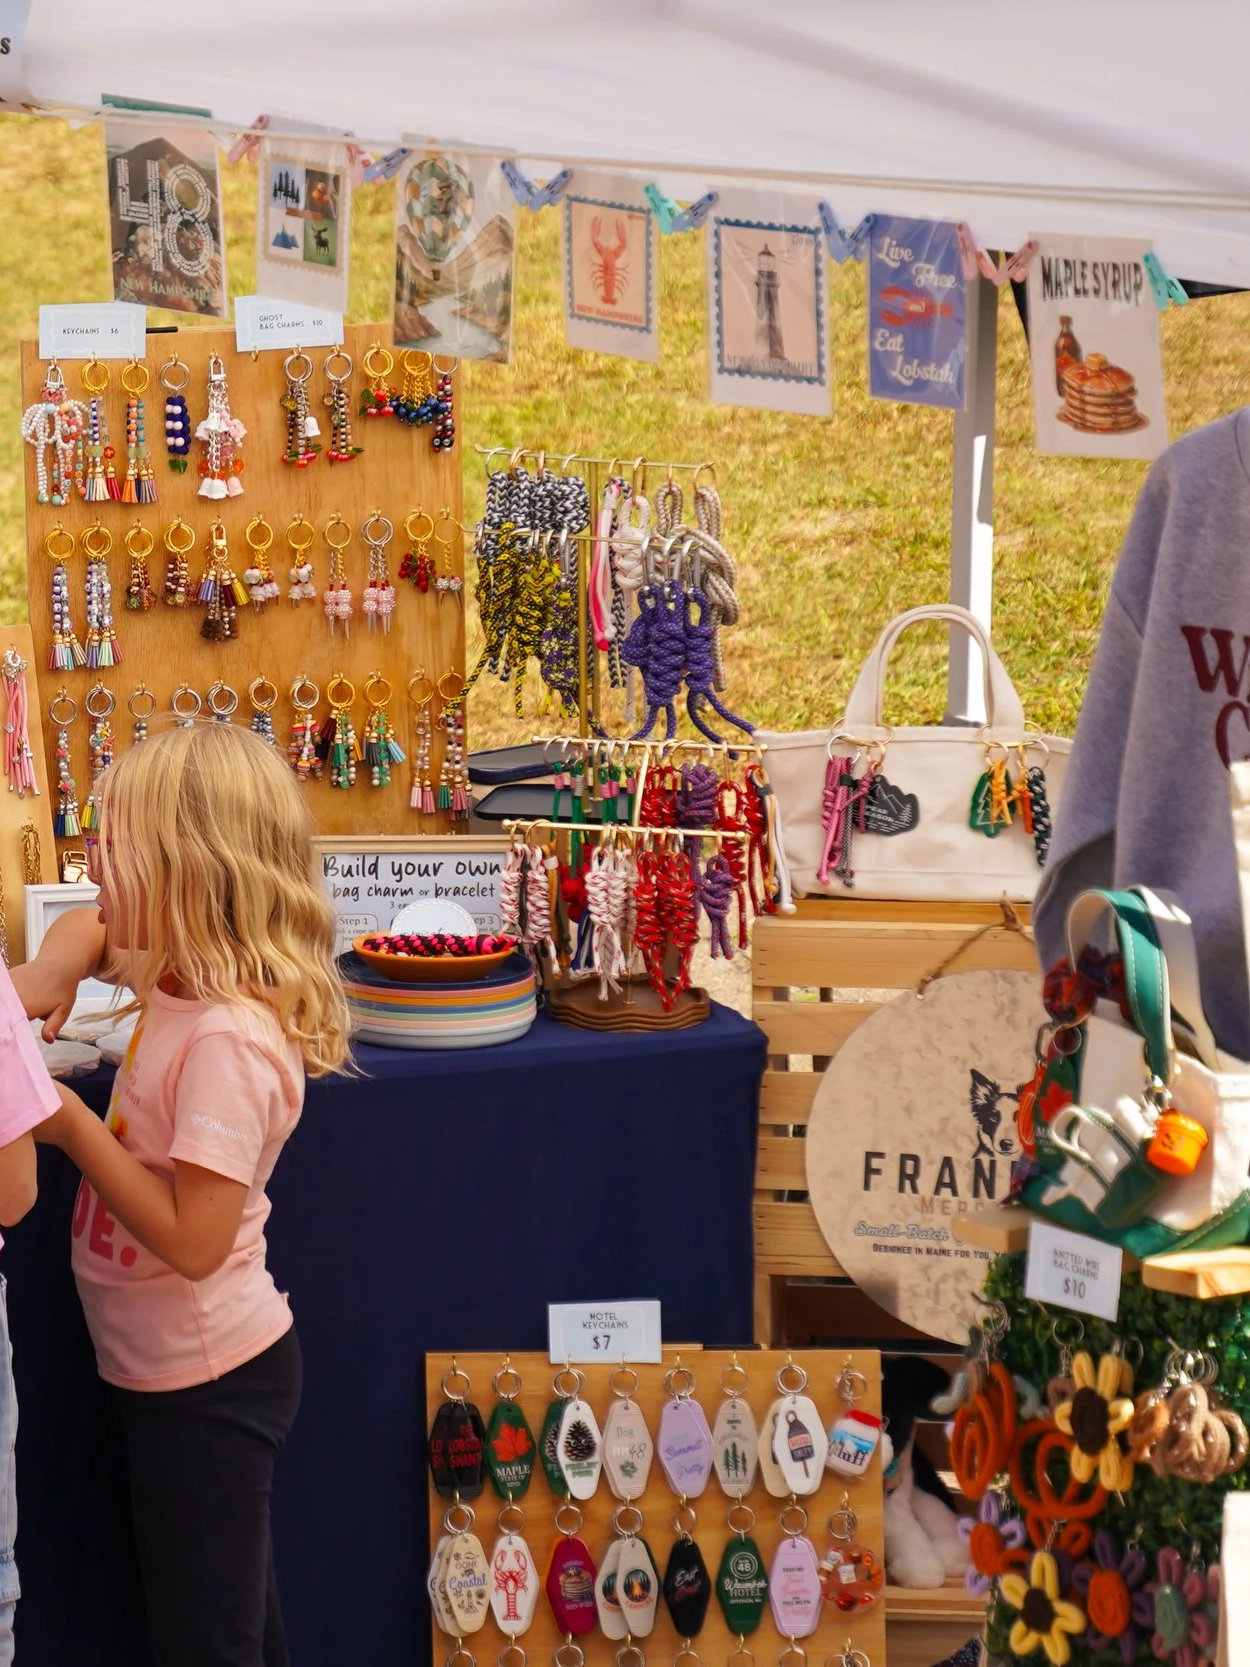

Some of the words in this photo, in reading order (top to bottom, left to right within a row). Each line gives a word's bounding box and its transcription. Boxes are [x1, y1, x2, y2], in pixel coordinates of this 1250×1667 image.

[877, 237, 914, 268] Live
[911, 262, 957, 288] Free
[1041, 255, 1089, 302] MAPLE
[1093, 259, 1143, 307] SYRUP
[120, 278, 144, 290] NEW
[62, 327, 100, 335] KEYCHAINS
[874, 328, 904, 352] Eat
[891, 355, 955, 386] Lobstah
[864, 810, 895, 823] EASON
[323, 855, 379, 880] Build
[391, 860, 444, 882] your
[455, 860, 501, 878] own
[332, 883, 360, 901] bag
[367, 883, 414, 898] charm
[419, 888, 429, 896] or
[435, 882, 496, 898] bracelet
[339, 917, 362, 927] Step
[364, 917, 369, 925] 1
[474, 917, 484, 926] ep
[488, 916, 494, 924] 3
[201, 1116, 248, 1142] Columbia
[863, 1151, 1014, 1199] FRAN
[854, 1221, 949, 1240] Small-Batch
[873, 1244, 912, 1255] DESIGNED
[915, 1247, 923, 1255] IN
[926, 1248, 952, 1257] MAINE
[955, 1249, 970, 1258] FOR
[1053, 1249, 1083, 1265] KNITTED
[1053, 1259, 1069, 1272] BAG
[1063, 1278, 1086, 1299] $10
[590, 1313, 618, 1321] MOTEL
[582, 1321, 629, 1330] KEYCHAINS
[593, 1335, 611, 1350] $7
[496, 1465, 530, 1477] MAPLE
[737, 1563, 751, 1572] 48
[450, 1572, 487, 1591] Coastal
[729, 1588, 763, 1597] HOTEL
